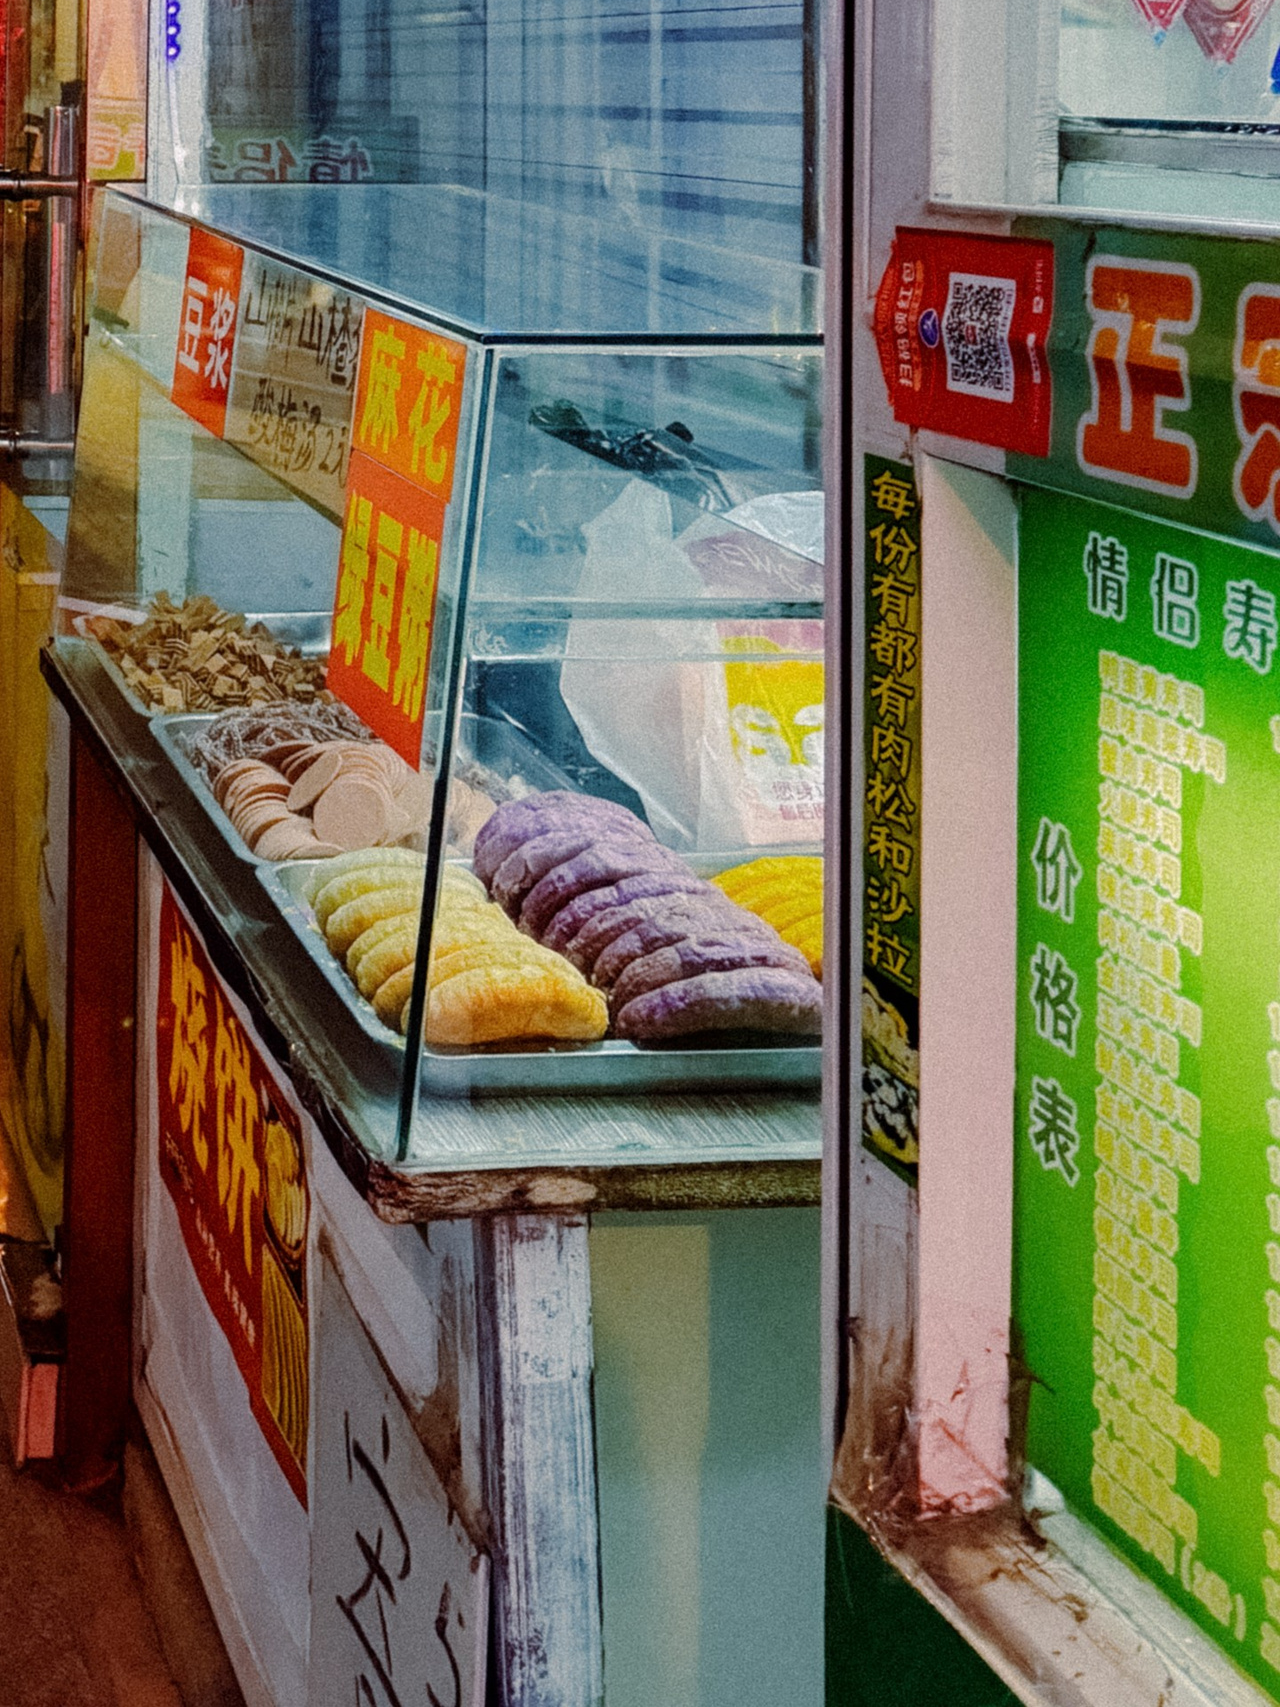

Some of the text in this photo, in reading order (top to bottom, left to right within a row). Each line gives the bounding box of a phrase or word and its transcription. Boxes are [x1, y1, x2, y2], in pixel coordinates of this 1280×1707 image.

[178, 275, 236, 390] 豆浆
[359, 324, 457, 485] 麻花
[869, 468, 918, 986] 每份有都有肉松和沙拉
[1083, 531, 1277, 674] 情侣寿
[169, 909, 261, 1277] 烧饼
[1029, 817, 1081, 1185] 价格表
